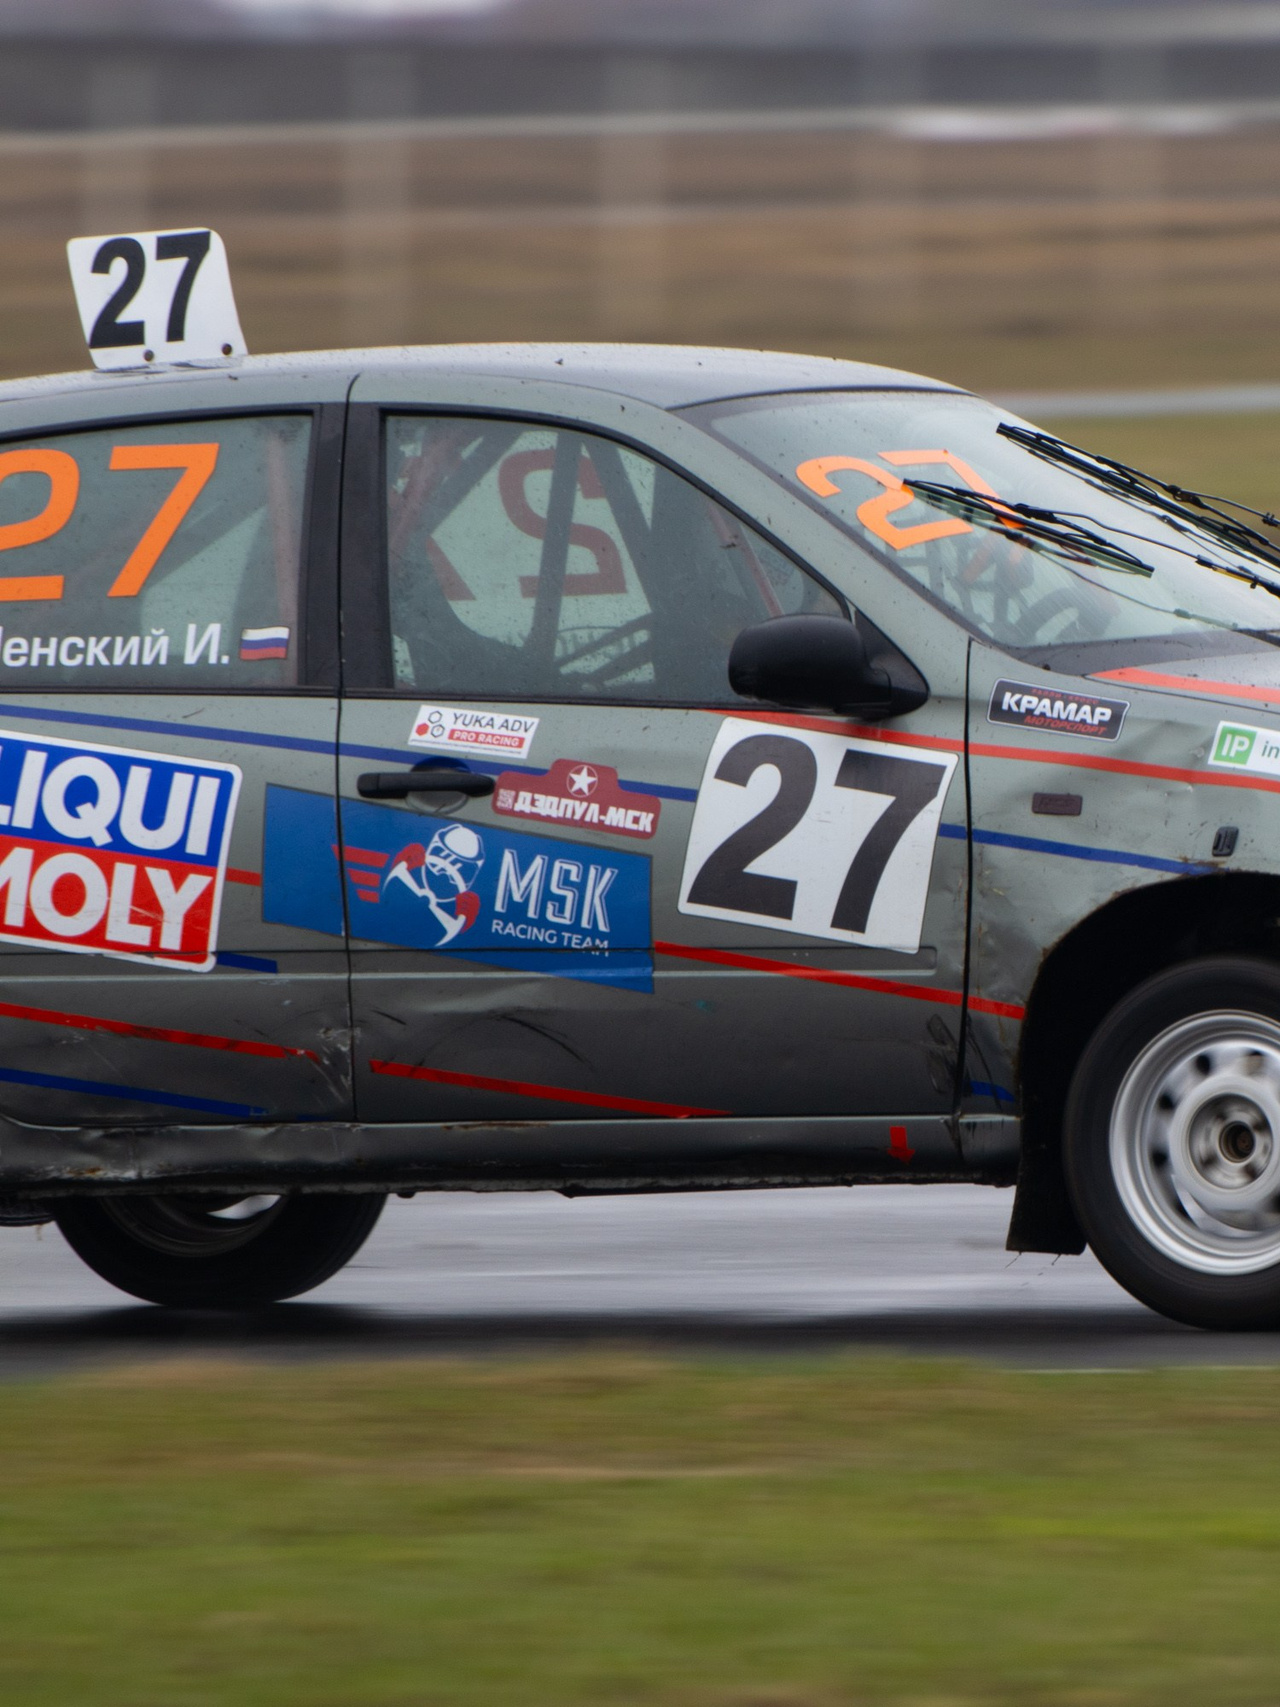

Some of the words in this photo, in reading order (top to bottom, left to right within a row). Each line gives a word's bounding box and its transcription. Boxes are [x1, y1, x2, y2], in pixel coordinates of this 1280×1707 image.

[89, 230, 211, 349] 27
[796, 449, 1026, 551] 27
[0, 443, 219, 600] 27
[0, 626, 169, 667] енский
[183, 623, 230, 665] И.
[453, 712, 495, 729] YUKA
[498, 716, 534, 733] ADV
[1001, 691, 1112, 725] КРАМАР
[1024, 715, 1108, 735] МОТОРСПОРТ
[453, 730, 476, 741] PRO
[477, 733, 520, 747] RACING
[1221, 733, 1250, 758] IP
[513, 791, 654, 833] ДЭДПУЛ-МСК
[686, 733, 948, 934] 27
[494, 848, 619, 933] MSK
[492, 920, 557, 944] RACING
[561, 931, 609, 957] TEAM
